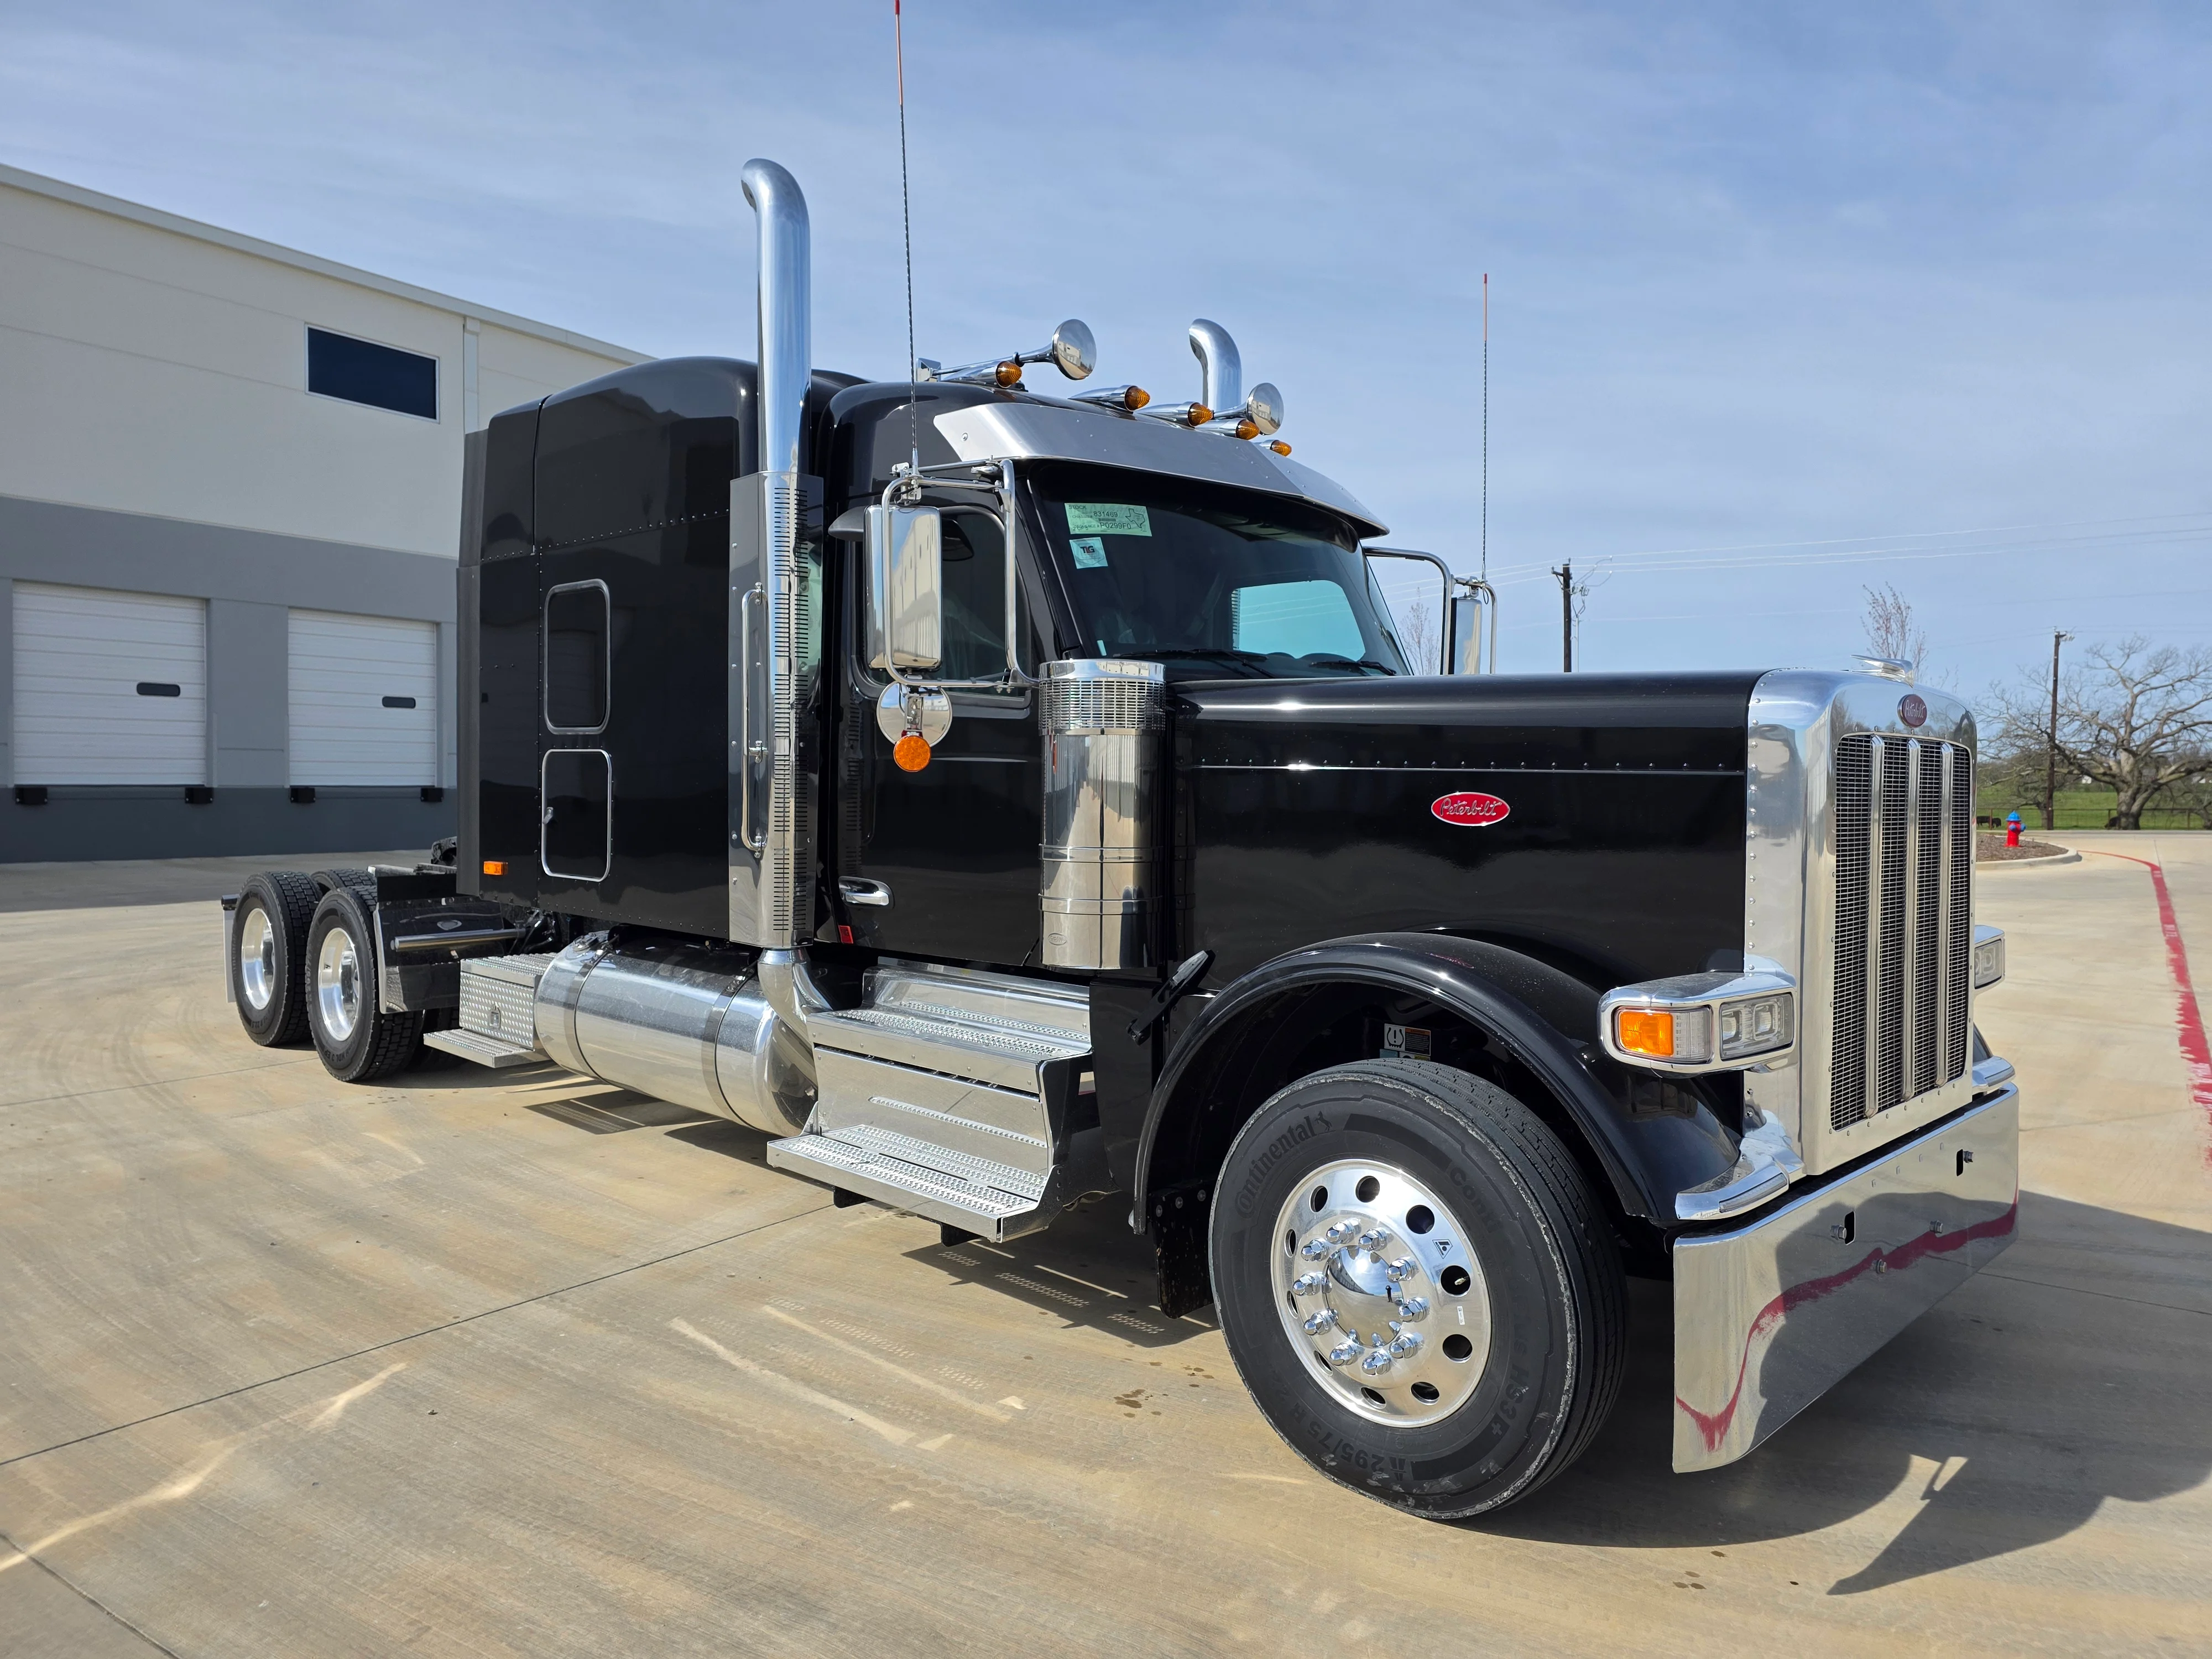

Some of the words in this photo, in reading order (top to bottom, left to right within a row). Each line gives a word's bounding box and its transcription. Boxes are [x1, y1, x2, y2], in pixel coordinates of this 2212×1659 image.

[1905, 700, 1926, 718] Peterbilt
[1439, 797, 1503, 816] Peterbilt
[1234, 1115, 1317, 1219] Continental
[1448, 1166, 1503, 1233] Conti
[1498, 1363, 1530, 1421] HS3
[1307, 1418, 1384, 1473] 295/75
